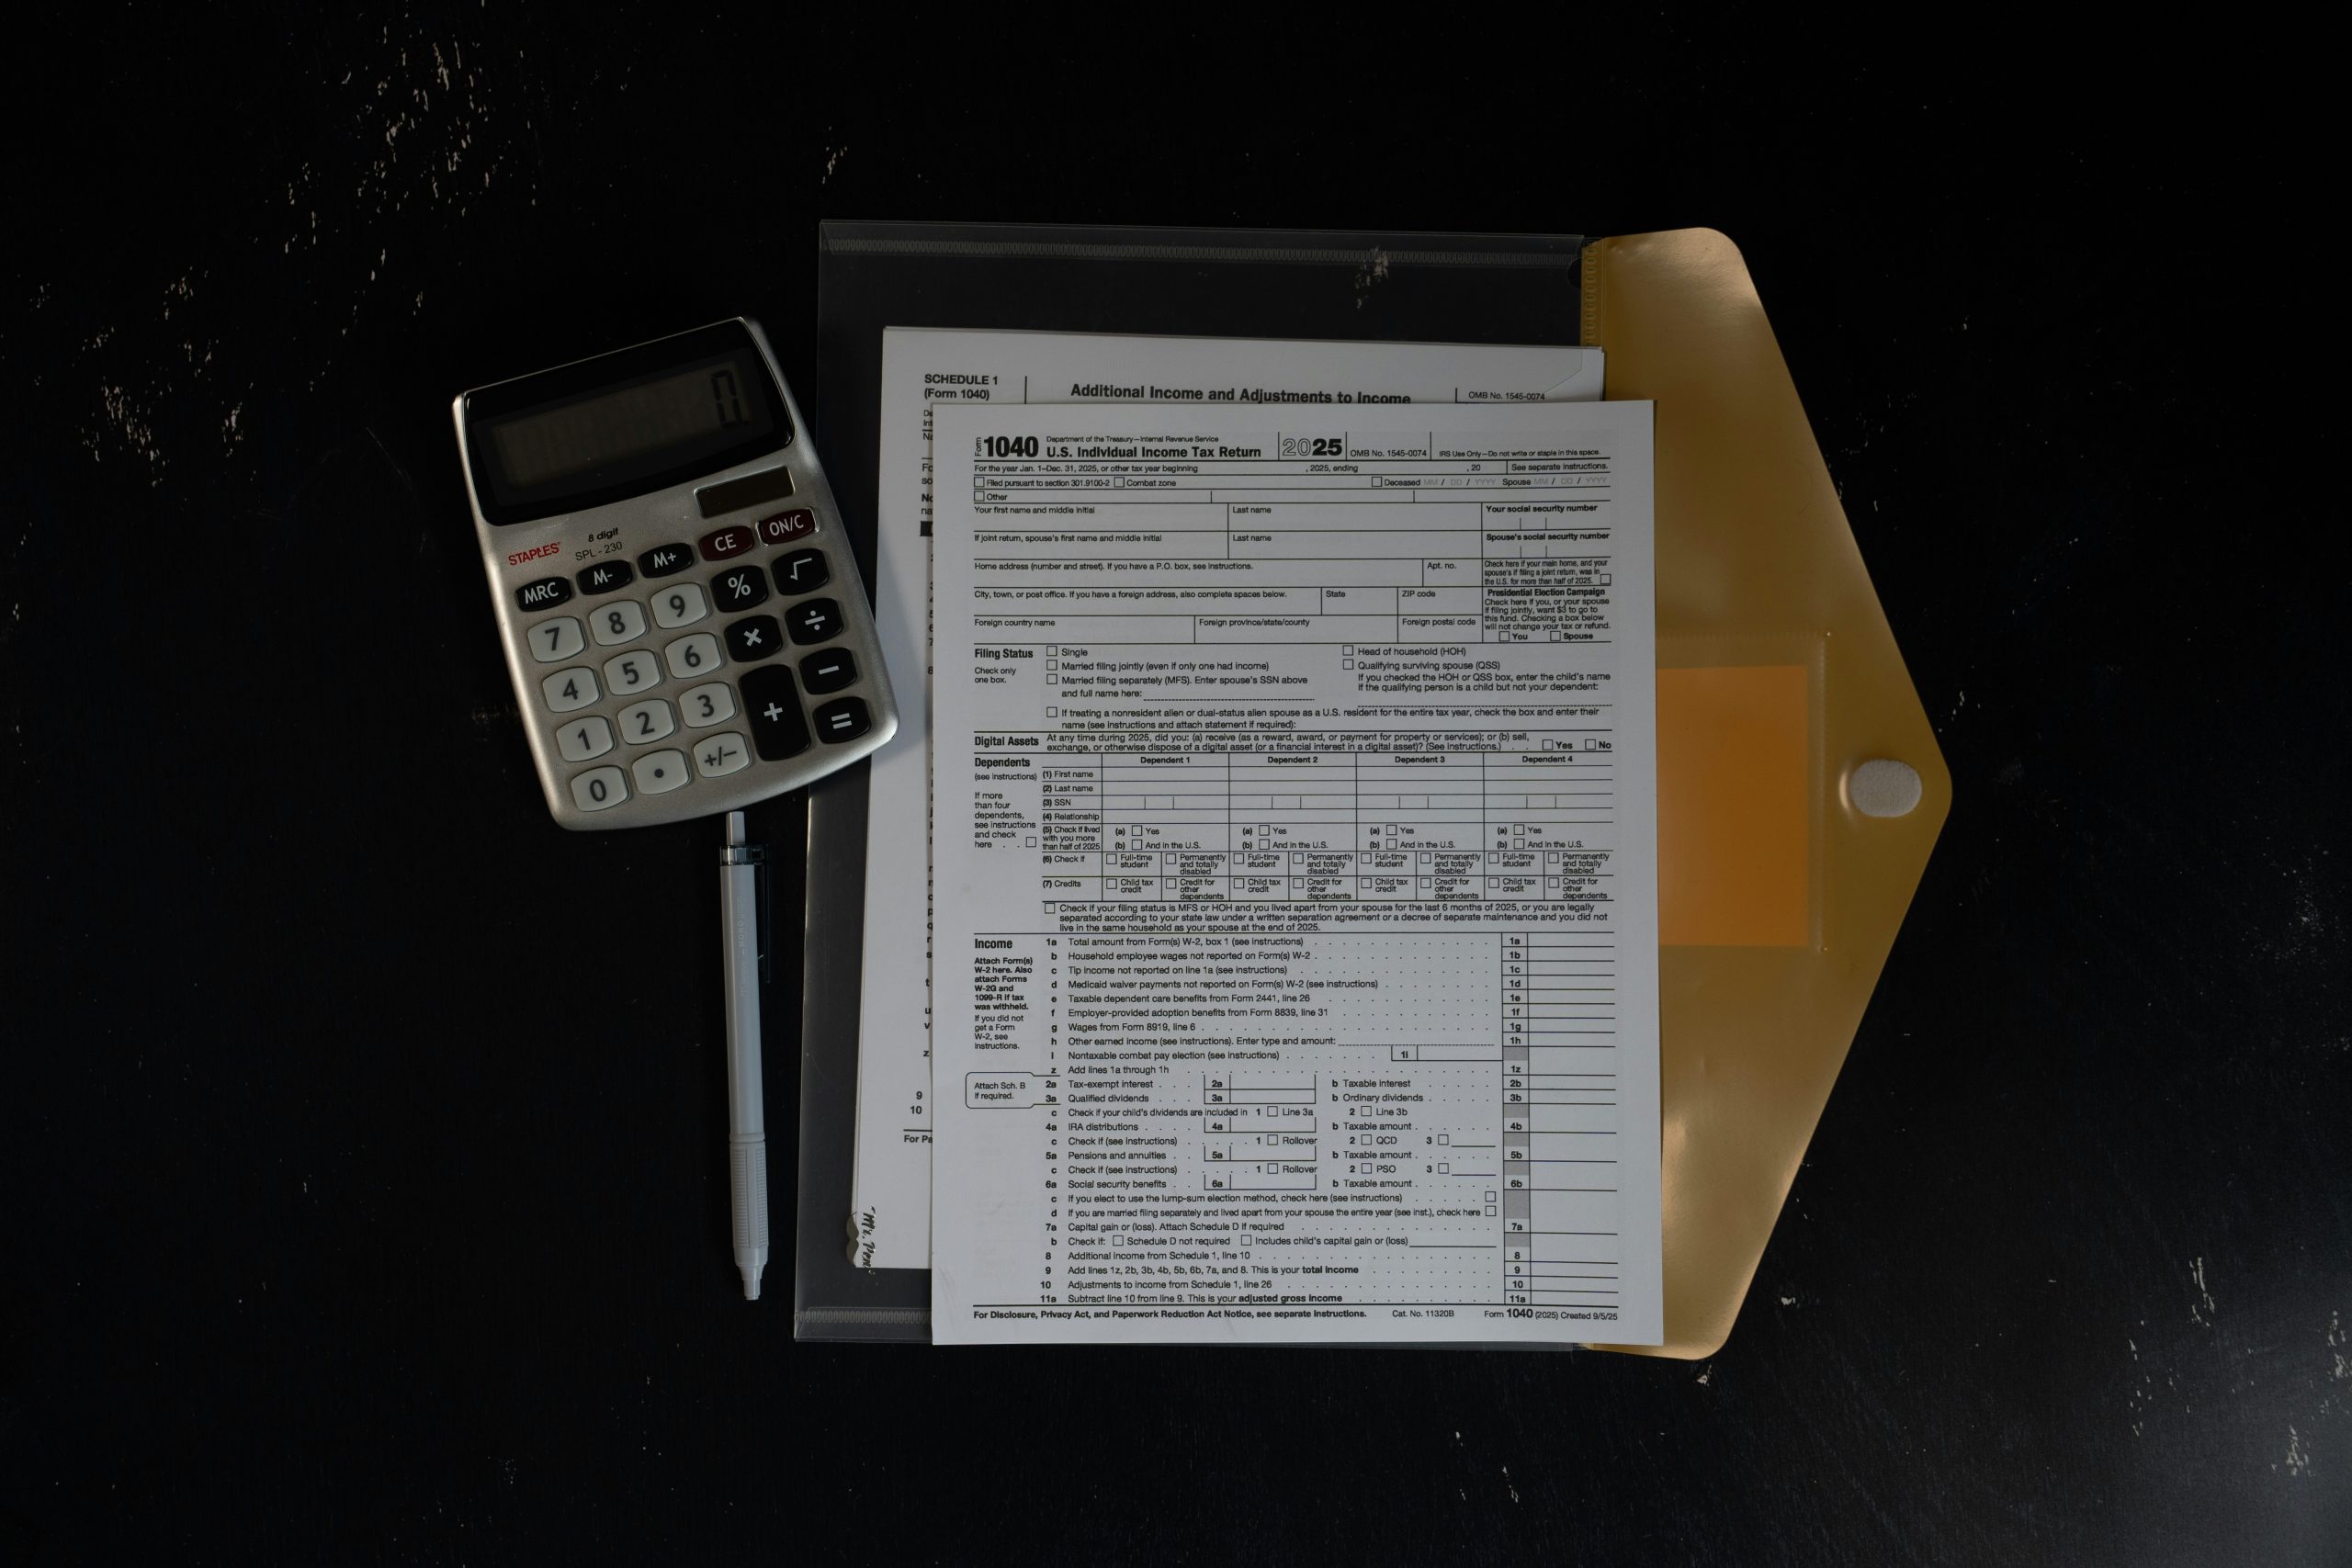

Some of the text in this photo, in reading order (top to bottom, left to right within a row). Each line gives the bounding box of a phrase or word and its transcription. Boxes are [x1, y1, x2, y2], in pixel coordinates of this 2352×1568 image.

[924, 373, 998, 386] SCHEDULE 1
[924, 388, 990, 401] (Form 1040)
[1070, 384, 1411, 404] Additional Income and Adjustments to Income
[1468, 390, 1547, 401] OMB No. 1545-0074
[1046, 435, 1084, 444] Department
[974, 436, 982, 457] Form
[983, 435, 1039, 458] 1040
[1046, 446, 1261, 458] U.S. Individual Income Tax Return
[1282, 437, 1343, 457] 2025
[1350, 449, 1428, 457] OMB No. 1545-0074
[974, 464, 988, 472] For
[1001, 466, 1019, 474] year
[1064, 464, 1077, 473] 31,
[1078, 464, 1099, 473] 2025,
[1144, 466, 1161, 474] year
[1162, 464, 1198, 474] beginning
[1510, 462, 1610, 472] See separate instructions.
[986, 479, 1003, 487] Filed
[1004, 479, 1035, 489] pursuant
[1046, 479, 1069, 487] section
[1070, 479, 1110, 487] 301.9100-2
[986, 492, 1008, 501] Other
[1532, 504, 1566, 513] security
[769, 514, 804, 536] ON/C
[588, 527, 618, 543] 8 digit
[714, 534, 737, 552] CE
[508, 543, 560, 566] STAPLES
[654, 552, 676, 569] M+
[594, 569, 613, 585] M-
[728, 573, 752, 599] %
[525, 581, 559, 604] MRC
[1487, 588, 1606, 597] Presidential Election Campaign
[669, 594, 685, 617] 9
[608, 612, 626, 635] 8
[545, 626, 560, 650] 7
[684, 645, 701, 668] 6
[975, 648, 1034, 660] Filing Status
[1061, 648, 1088, 658] Single
[1358, 647, 1466, 657] Head of household (HOH)
[1061, 662, 1094, 671] Married
[1096, 661, 1116, 671] filing
[1117, 661, 1145, 671] jointly
[1146, 661, 1170, 671] (even
[1170, 661, 1177, 671] if
[1178, 661, 1197, 671] only
[1216, 661, 1233, 671] had
[1235, 661, 1270, 671] income)
[1358, 660, 1500, 671] Qualifying surviving spouse (QSS)
[622, 661, 639, 684] 5
[562, 678, 579, 700] 4
[696, 694, 714, 717] 3
[763, 703, 783, 722] +
[636, 712, 655, 735] 2
[831, 713, 853, 729] =
[578, 728, 591, 750] 1
[974, 736, 1039, 748] Digital Assets
[1599, 740, 1611, 750] No
[1555, 741, 1573, 750] Yes
[974, 757, 1031, 769] Dependents
[589, 779, 606, 802] 0
[975, 938, 1013, 949] Income
[1046, 938, 1057, 946] 1a
[1068, 937, 1304, 948] Total amount from Form(s) W-2, box 1 (see instructions)
[1068, 1079, 1154, 1089] Tax-exempt interest
[916, 1090, 923, 1100] 9
[1342, 1093, 1424, 1104] Ordinary dividends
[910, 1105, 922, 1115] 10
[904, 1134, 920, 1144] For
[973, 1311, 989, 1319] For
[990, 1310, 1038, 1320] Disclosure,
[1040, 1310, 1073, 1320] Privacy
[1074, 1310, 1091, 1320] Act,
[1093, 1310, 1110, 1318] and
[1112, 1310, 1159, 1320] Paperwork
[1160, 1310, 1204, 1318] Reduction
[1206, 1309, 1222, 1318] Act
[1224, 1309, 1254, 1319] Notice,
[1274, 1311, 1311, 1320] separate
[1314, 1310, 1367, 1318] instructions.
[1392, 1309, 1408, 1318] Cat.
[1425, 1309, 1454, 1317] 11320B
[1484, 1308, 1618, 1321] Form 1040 (2025) Created 9/5/25
